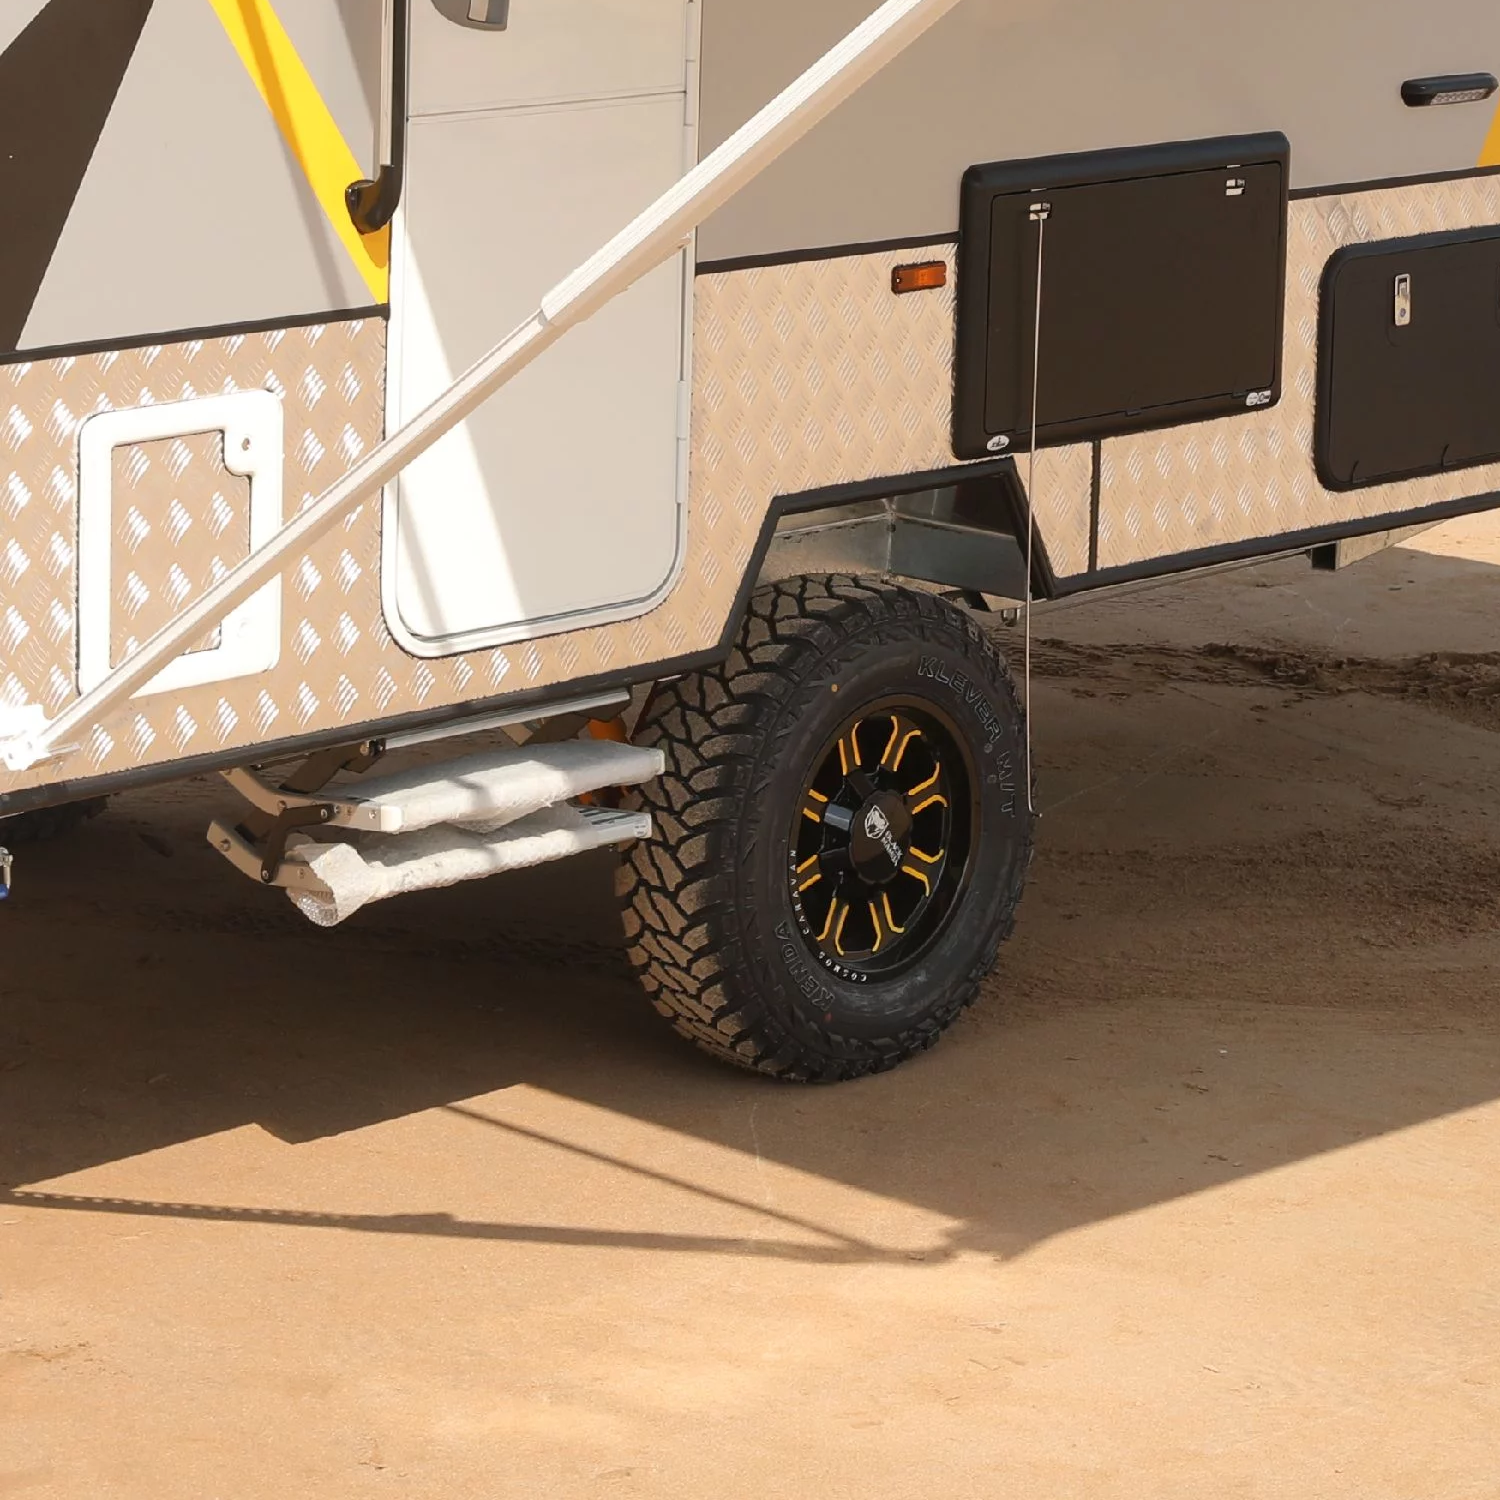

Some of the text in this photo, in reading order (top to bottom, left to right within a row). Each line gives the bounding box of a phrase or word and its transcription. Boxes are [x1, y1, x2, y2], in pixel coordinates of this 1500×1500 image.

[917, 655, 1003, 744] KLEVER
[789, 849, 868, 982] COSMOS CARAVAN
[774, 920, 836, 1012] KENDA
